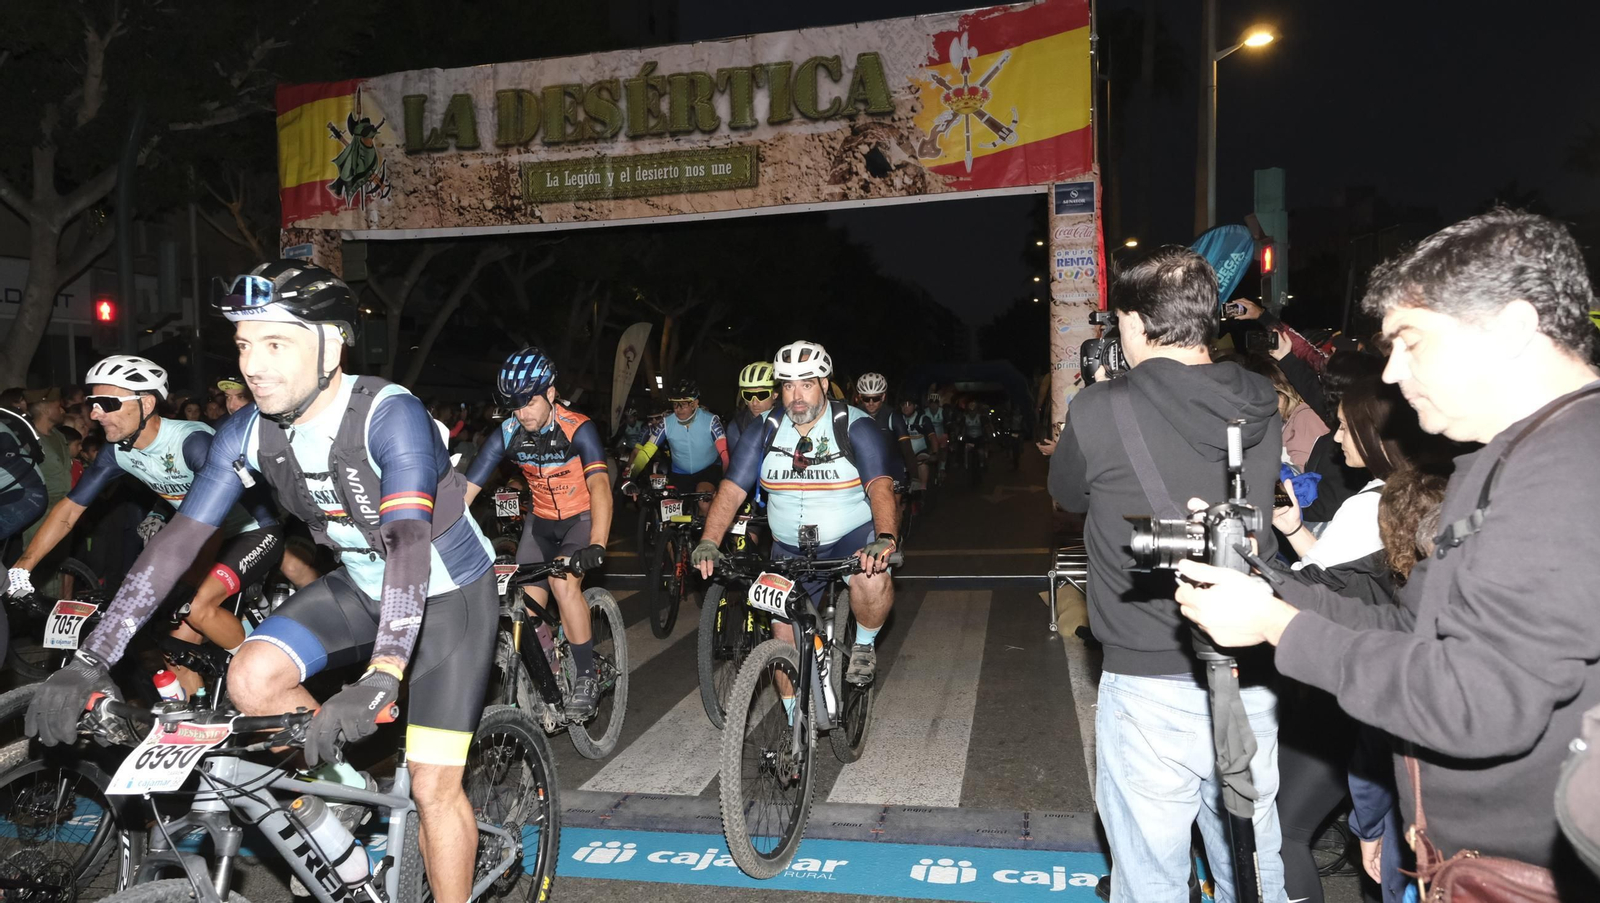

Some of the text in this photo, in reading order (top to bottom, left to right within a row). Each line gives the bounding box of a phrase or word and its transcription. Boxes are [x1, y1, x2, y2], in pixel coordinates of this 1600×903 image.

[402, 51, 896, 151] LA DESÉRTICA
[546, 163, 732, 189] La Legión y el desierto nos une
[1057, 257, 1094, 267] RENTA
[766, 469, 779, 480] LA
[664, 504, 681, 514] 7884
[243, 533, 275, 565] MORAYMA
[754, 585, 783, 609] 6116
[52, 615, 84, 635] 7057
[135, 745, 207, 769] 6950
[647, 848, 849, 874] cajaar
[784, 871, 837, 881] RURAL
[992, 866, 1108, 892] caja
